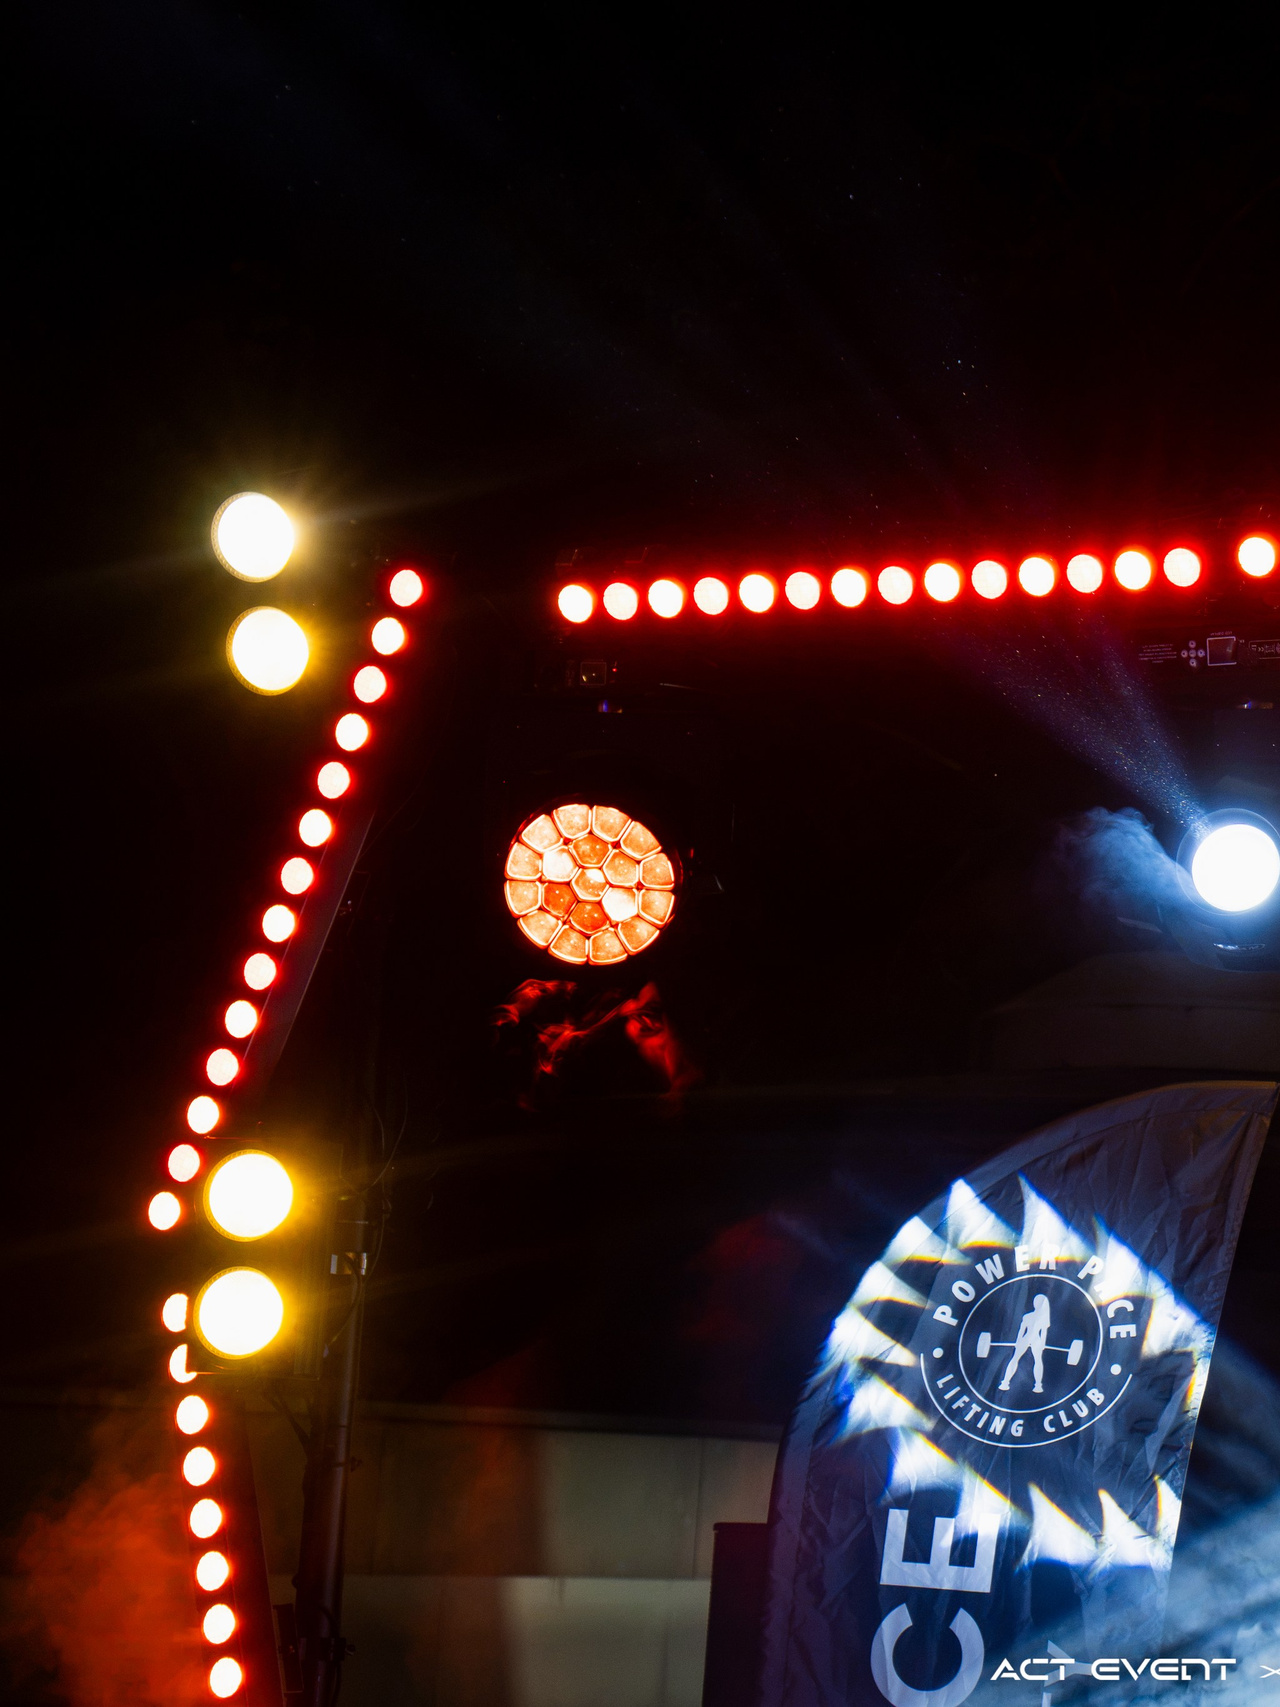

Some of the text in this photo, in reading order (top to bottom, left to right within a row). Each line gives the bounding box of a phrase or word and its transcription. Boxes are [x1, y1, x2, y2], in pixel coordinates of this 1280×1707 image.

[932, 1244, 1061, 1327] POWER
[936, 1373, 1105, 1437] LIFTING CLUB
